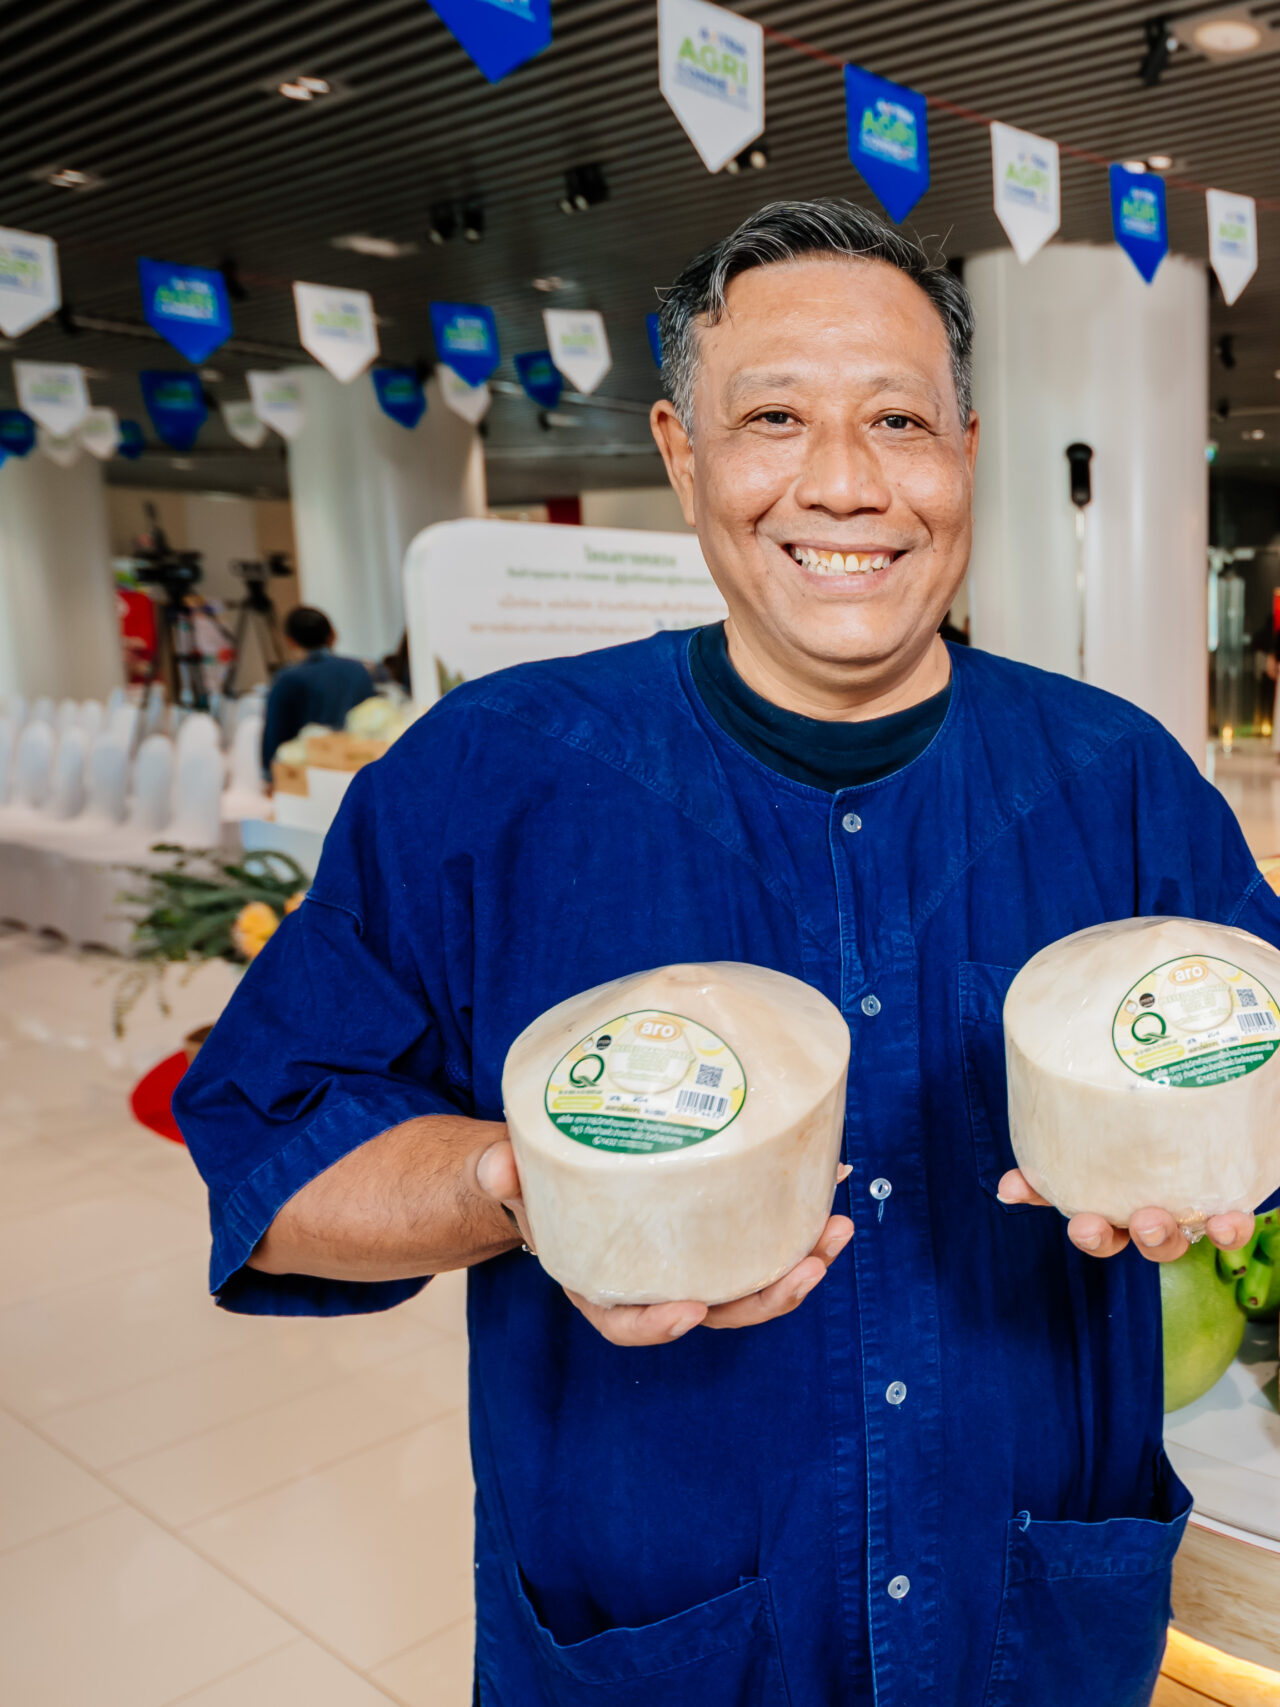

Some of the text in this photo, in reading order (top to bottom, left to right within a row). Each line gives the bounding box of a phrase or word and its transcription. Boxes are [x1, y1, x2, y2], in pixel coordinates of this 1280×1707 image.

[678, 36, 748, 88] AGRI
[1174, 966, 1203, 982] aro
[640, 1021, 675, 1038] aro
